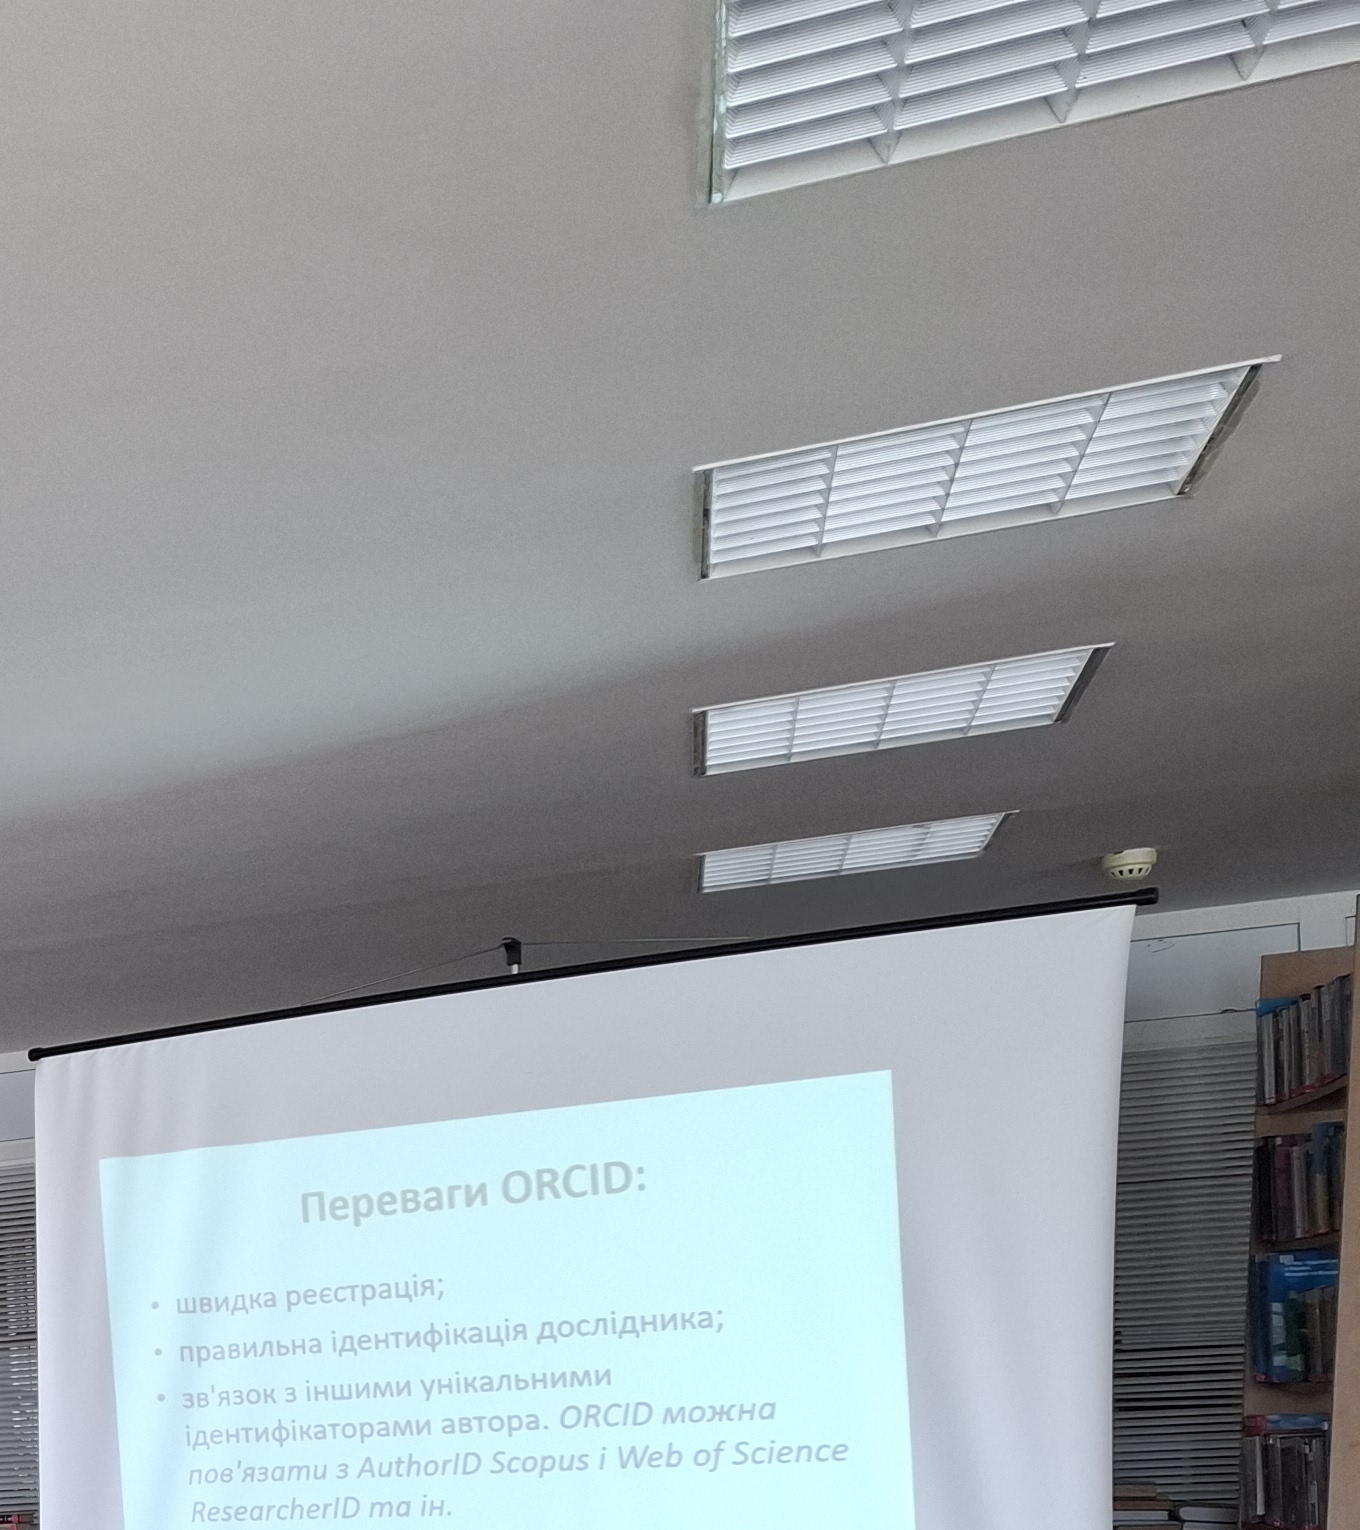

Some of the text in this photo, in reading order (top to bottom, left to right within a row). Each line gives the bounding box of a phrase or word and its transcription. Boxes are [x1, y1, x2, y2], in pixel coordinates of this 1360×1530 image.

[301, 1161, 646, 1227] Переваги ORCID:
[176, 1274, 445, 1316] швидка реєстрація;
[179, 1309, 724, 1367] правильна ідентифікація дослідника;
[182, 1368, 612, 1409] зв'язок з іншими унікальними
[185, 1401, 776, 1451] ідентифікаторами автора. ORCID можна
[188, 1460, 327, 1485] пов'язати
[335, 1462, 349, 1479] з
[357, 1451, 482, 1479] AuthorID
[489, 1451, 589, 1478] Scopus
[617, 1442, 683, 1470] Web
[693, 1440, 727, 1472] of
[731, 1439, 849, 1466] Science
[191, 1494, 452, 1523] ResearcherID та ін.
